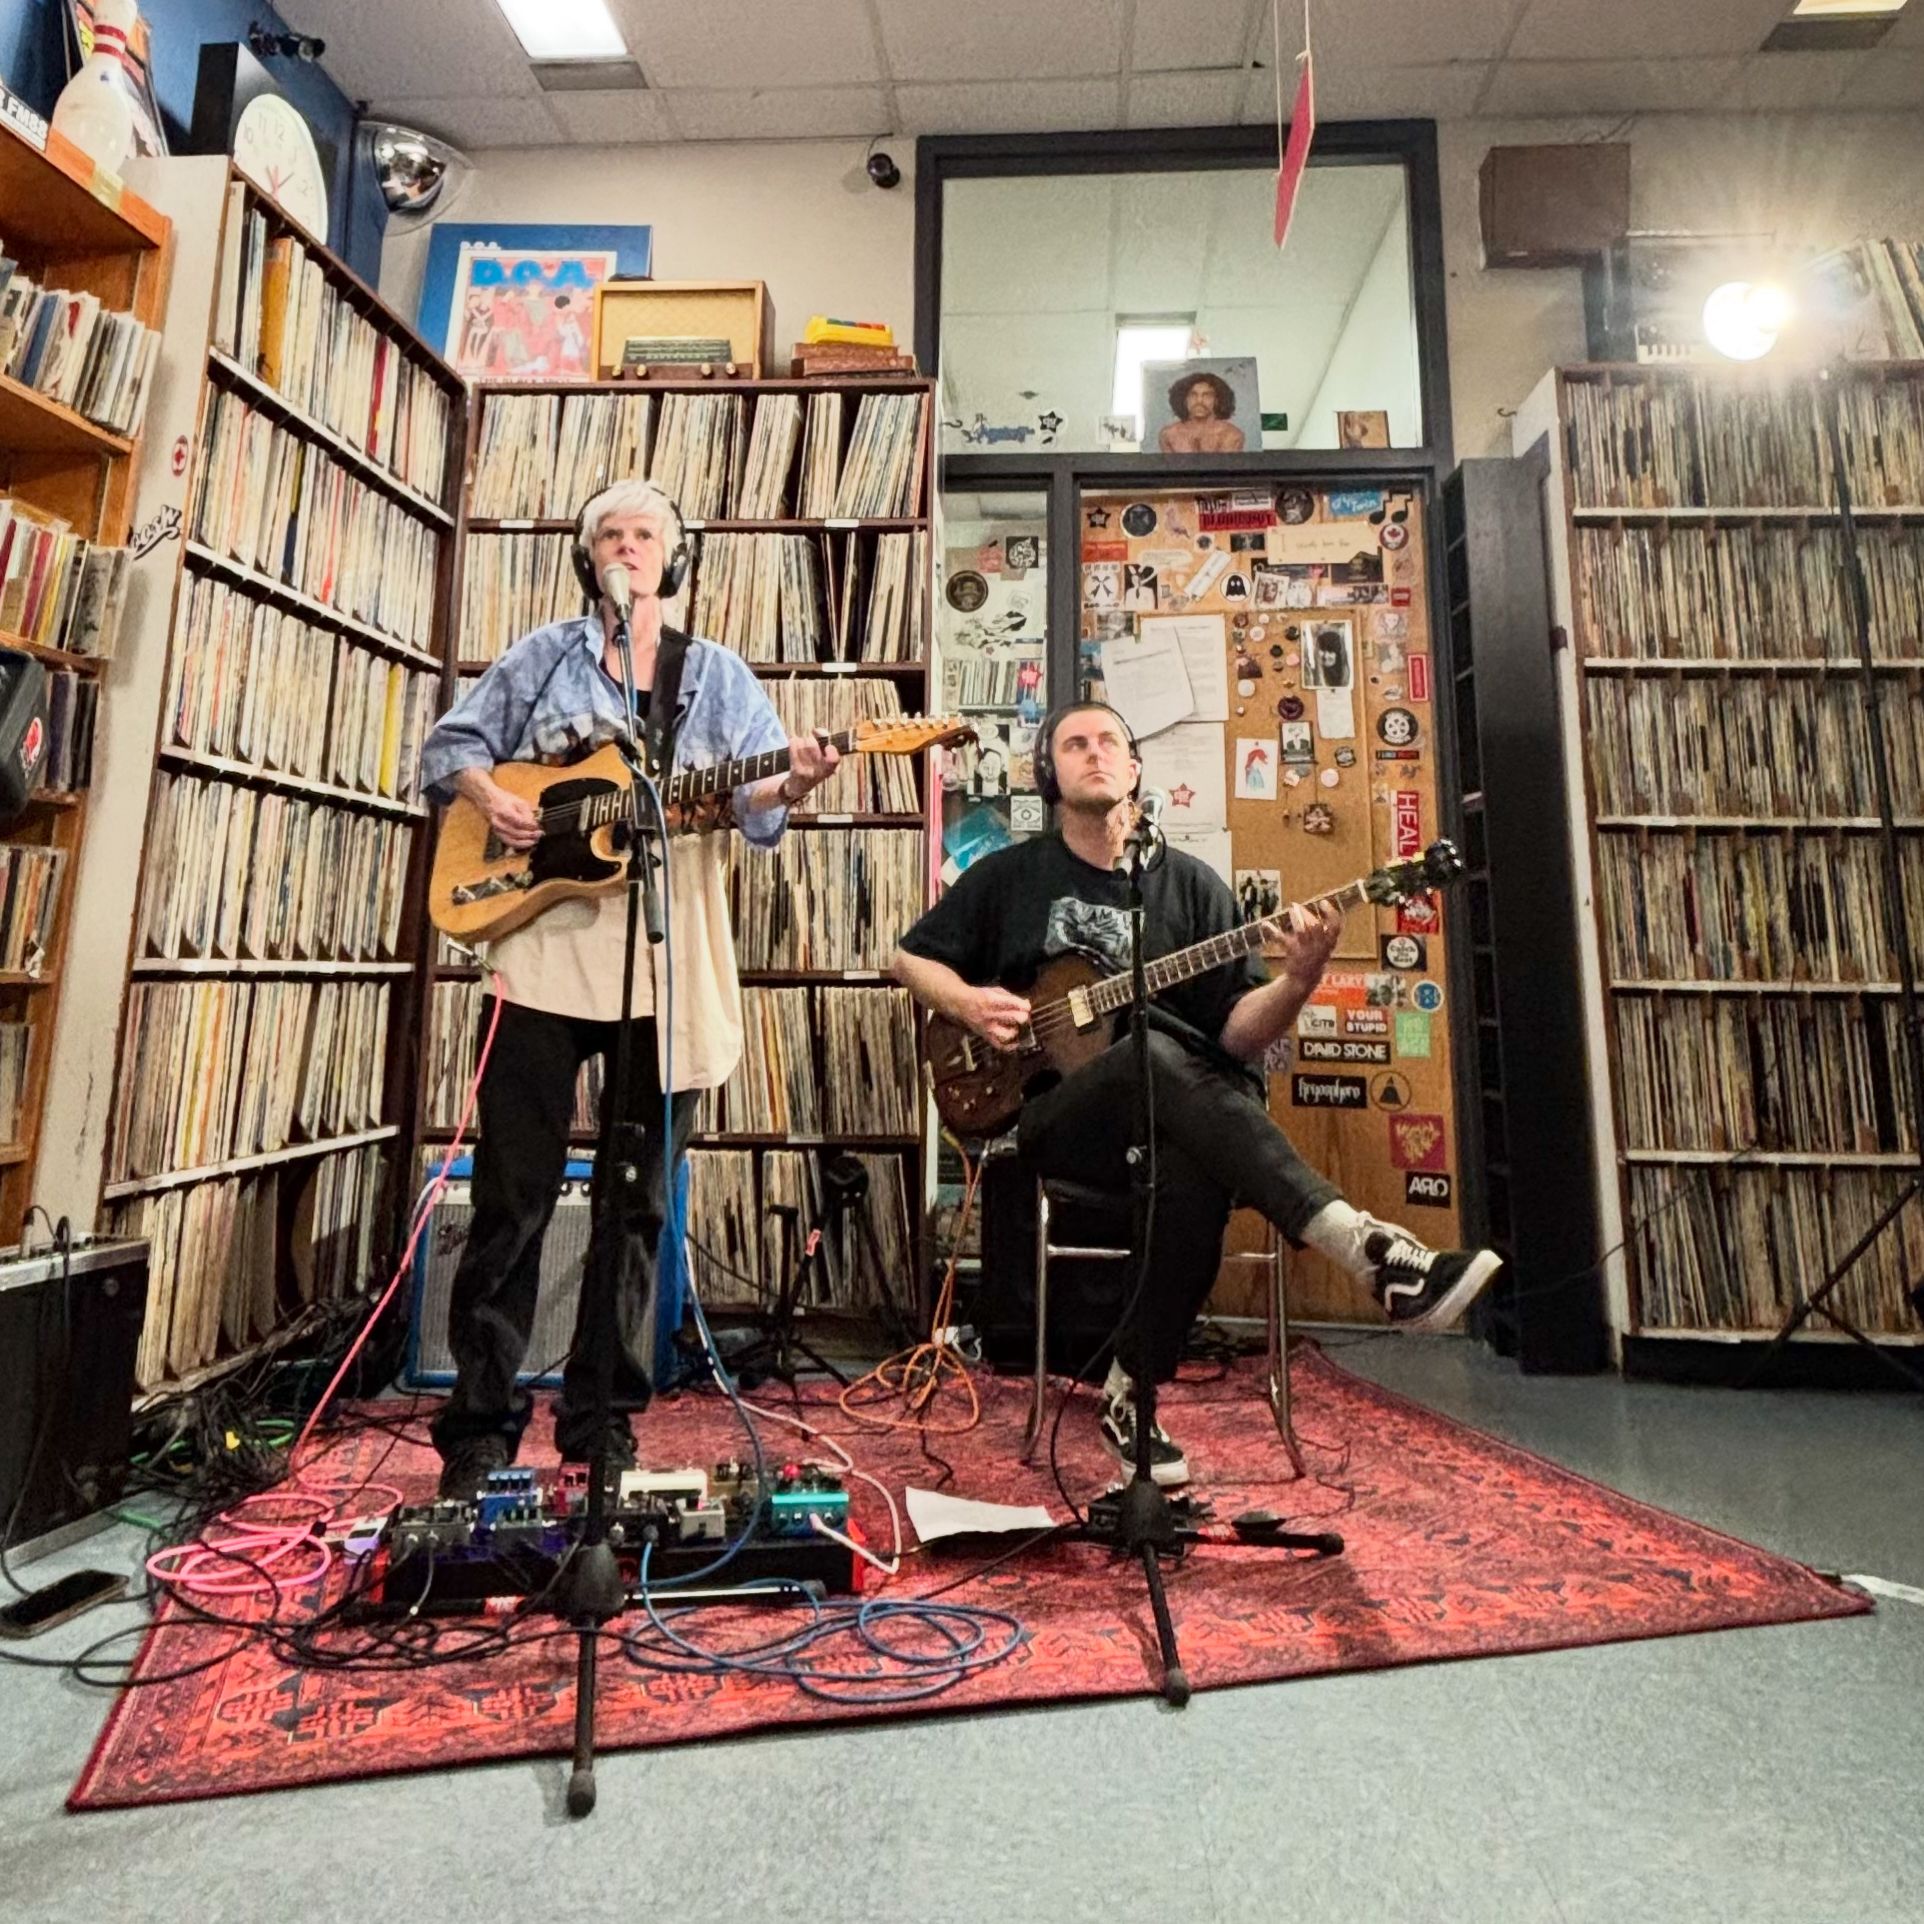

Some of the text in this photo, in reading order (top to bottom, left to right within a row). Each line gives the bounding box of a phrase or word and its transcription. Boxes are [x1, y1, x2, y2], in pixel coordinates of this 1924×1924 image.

[1398, 794, 1418, 860] HEAL
[1346, 1009, 1383, 1020] YOUR
[1304, 1042, 1341, 1056] DAVID
[1343, 1043, 1386, 1059] STONE
